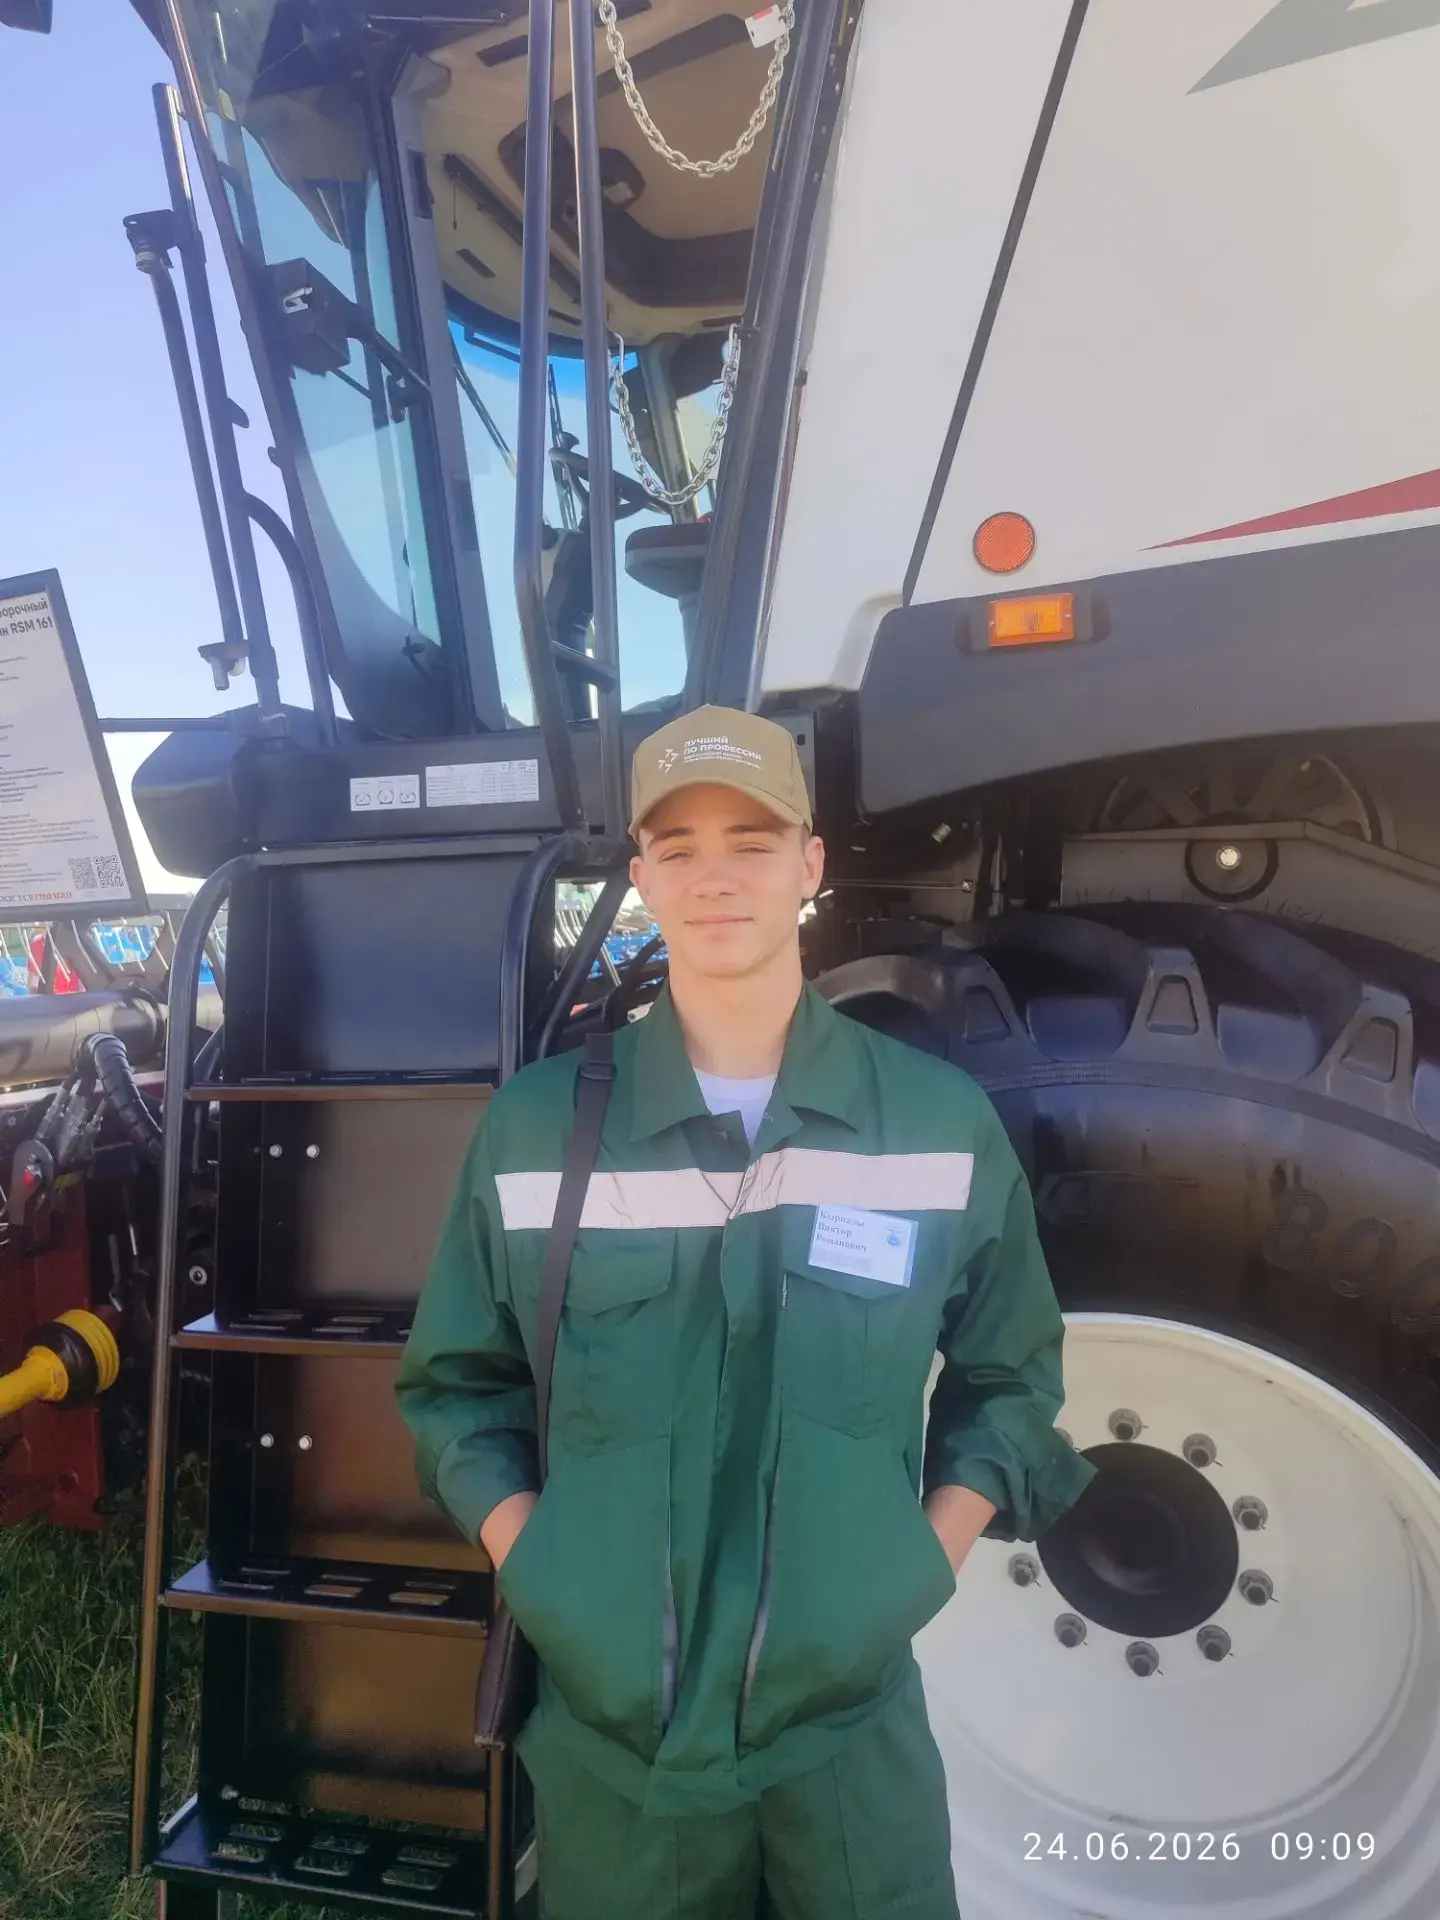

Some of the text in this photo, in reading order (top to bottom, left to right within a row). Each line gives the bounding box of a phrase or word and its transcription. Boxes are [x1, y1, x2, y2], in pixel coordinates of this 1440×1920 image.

[0, 598, 49, 618] орочный
[10, 619, 35, 635] RSM
[36, 615, 54, 630] 161
[684, 736, 729, 748] ЛУЧШИЙ
[683, 747, 698, 756] ПО
[700, 744, 762, 761] ПРОФЕССИИ
[818, 1222, 852, 1237] Виктор
